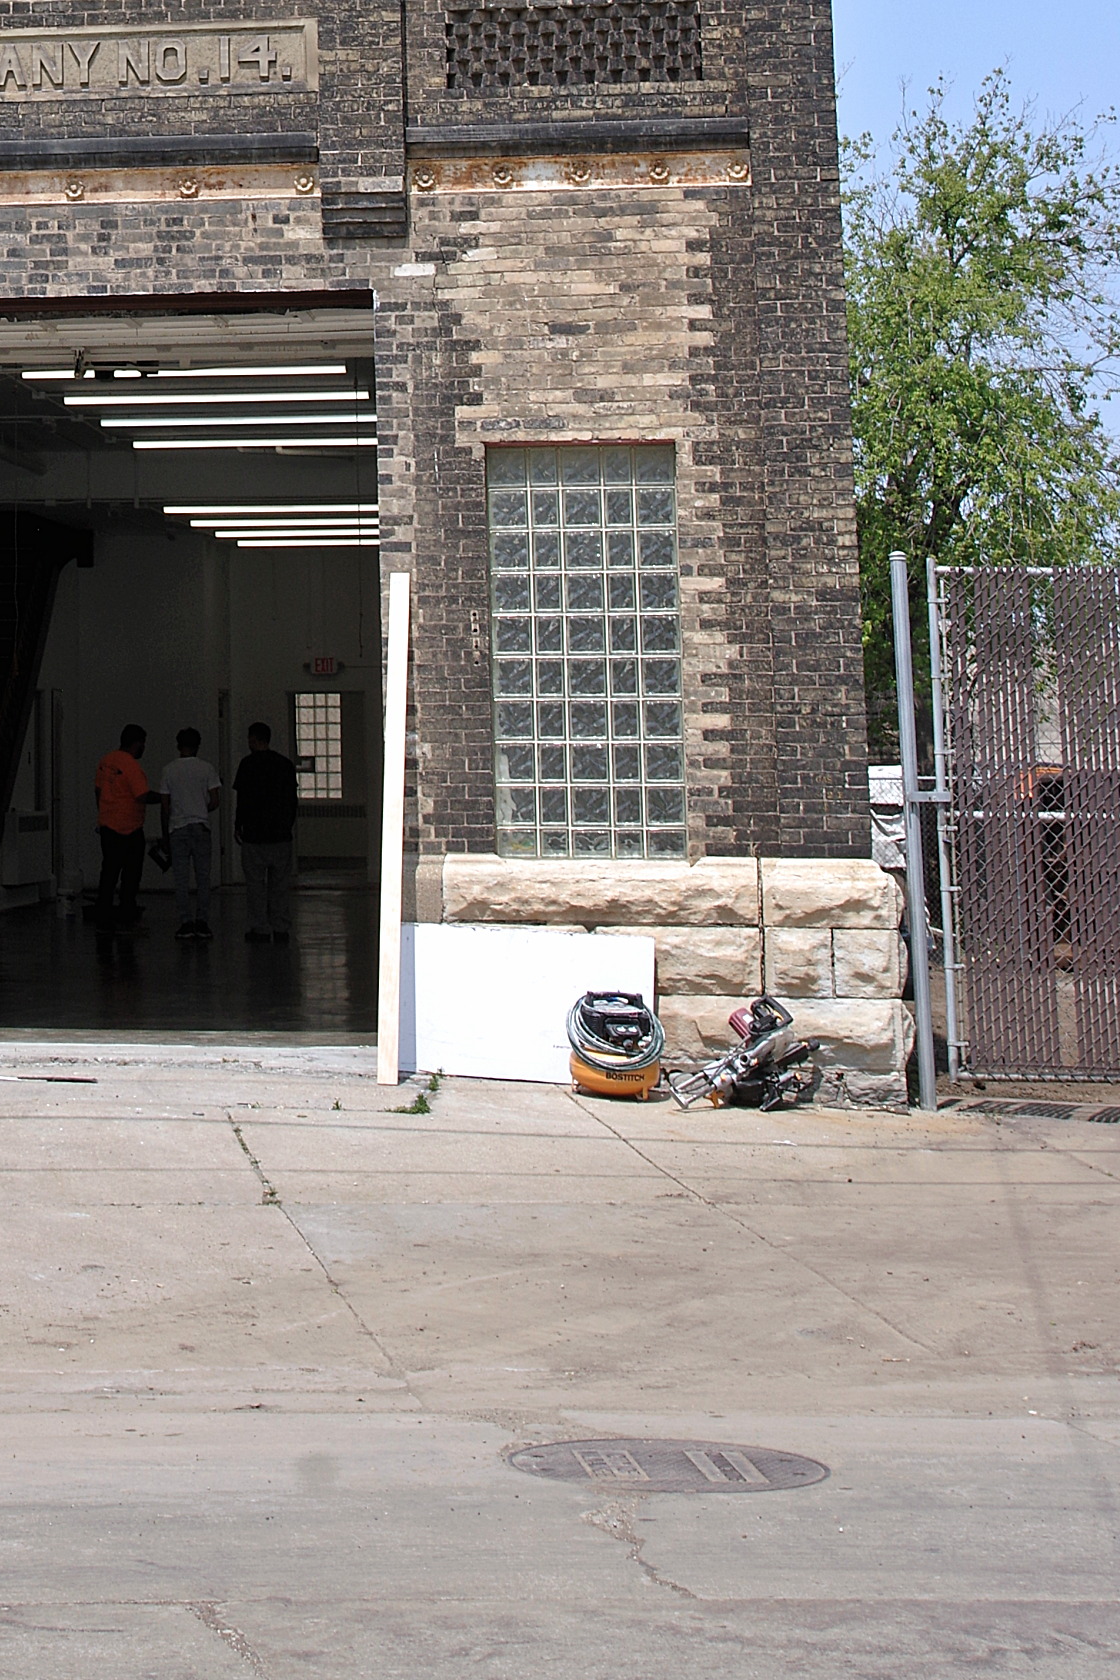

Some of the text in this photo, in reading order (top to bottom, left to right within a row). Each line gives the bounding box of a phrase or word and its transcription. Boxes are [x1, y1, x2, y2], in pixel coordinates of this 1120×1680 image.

[118, 38, 209, 86] NO.
[220, 35, 292, 83] 14.
[314, 656, 334, 672] EXIT
[605, 1071, 645, 1082] BOSTITCH
